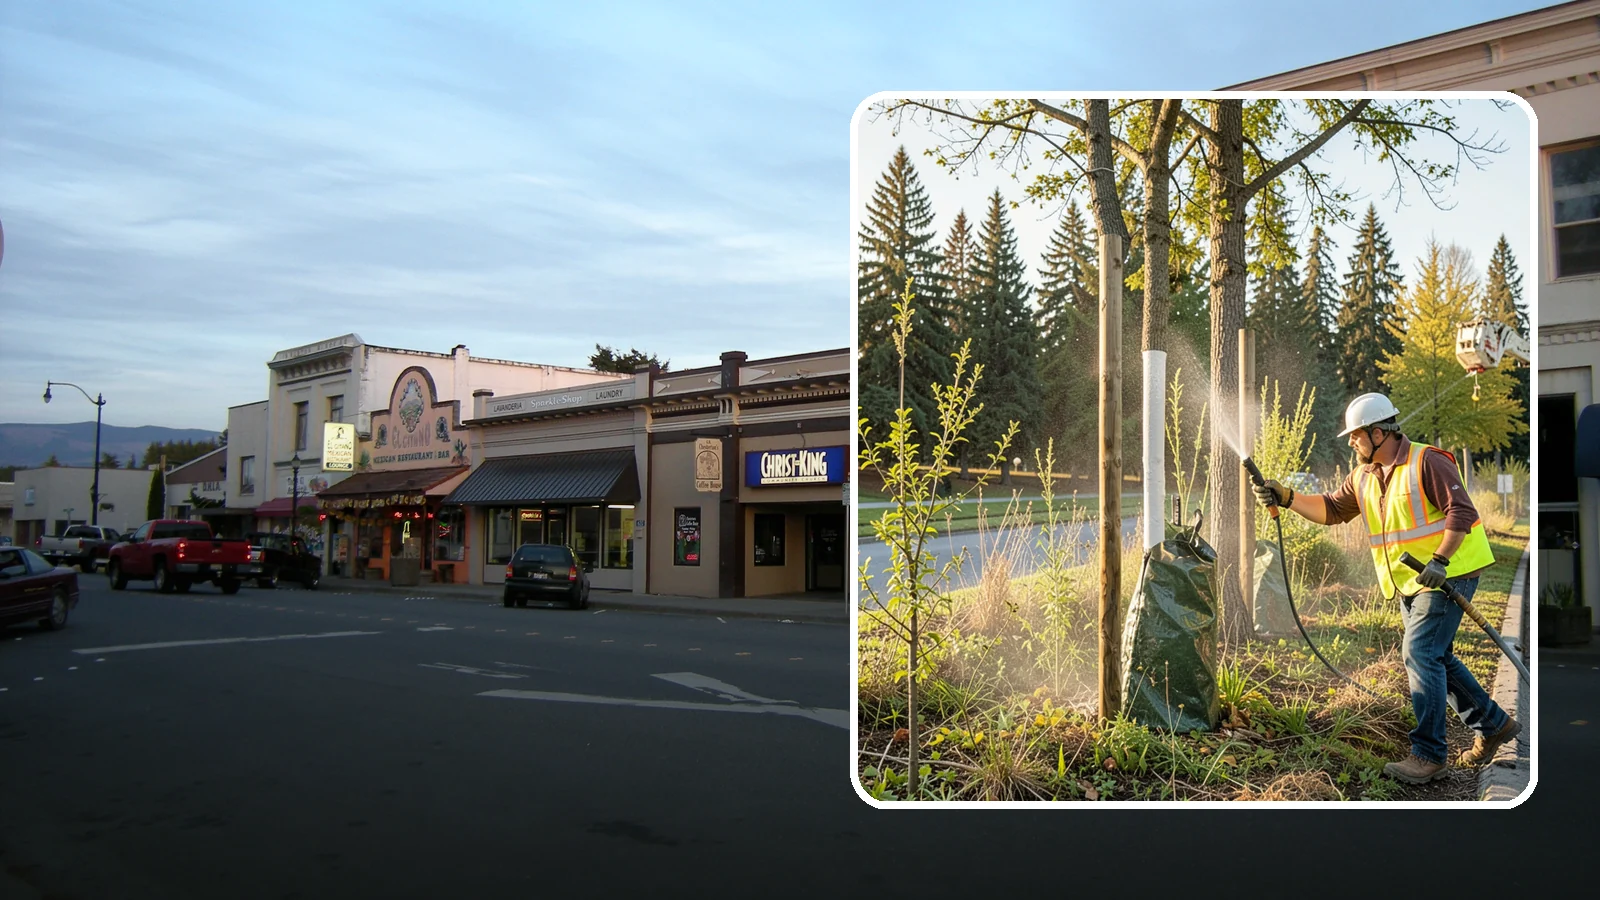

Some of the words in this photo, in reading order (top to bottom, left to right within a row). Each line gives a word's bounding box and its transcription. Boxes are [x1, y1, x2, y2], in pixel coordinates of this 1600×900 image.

[494, 402, 523, 413] LAVANDERIA
[561, 394, 583, 405] Shop
[595, 389, 624, 400] LAUNDRY
[373, 455, 396, 464] MEXICAN
[397, 451, 433, 462] RESTAURANT
[437, 450, 450, 459] BAR
[761, 452, 797, 478] CHRIST
[799, 450, 827, 476] KING
